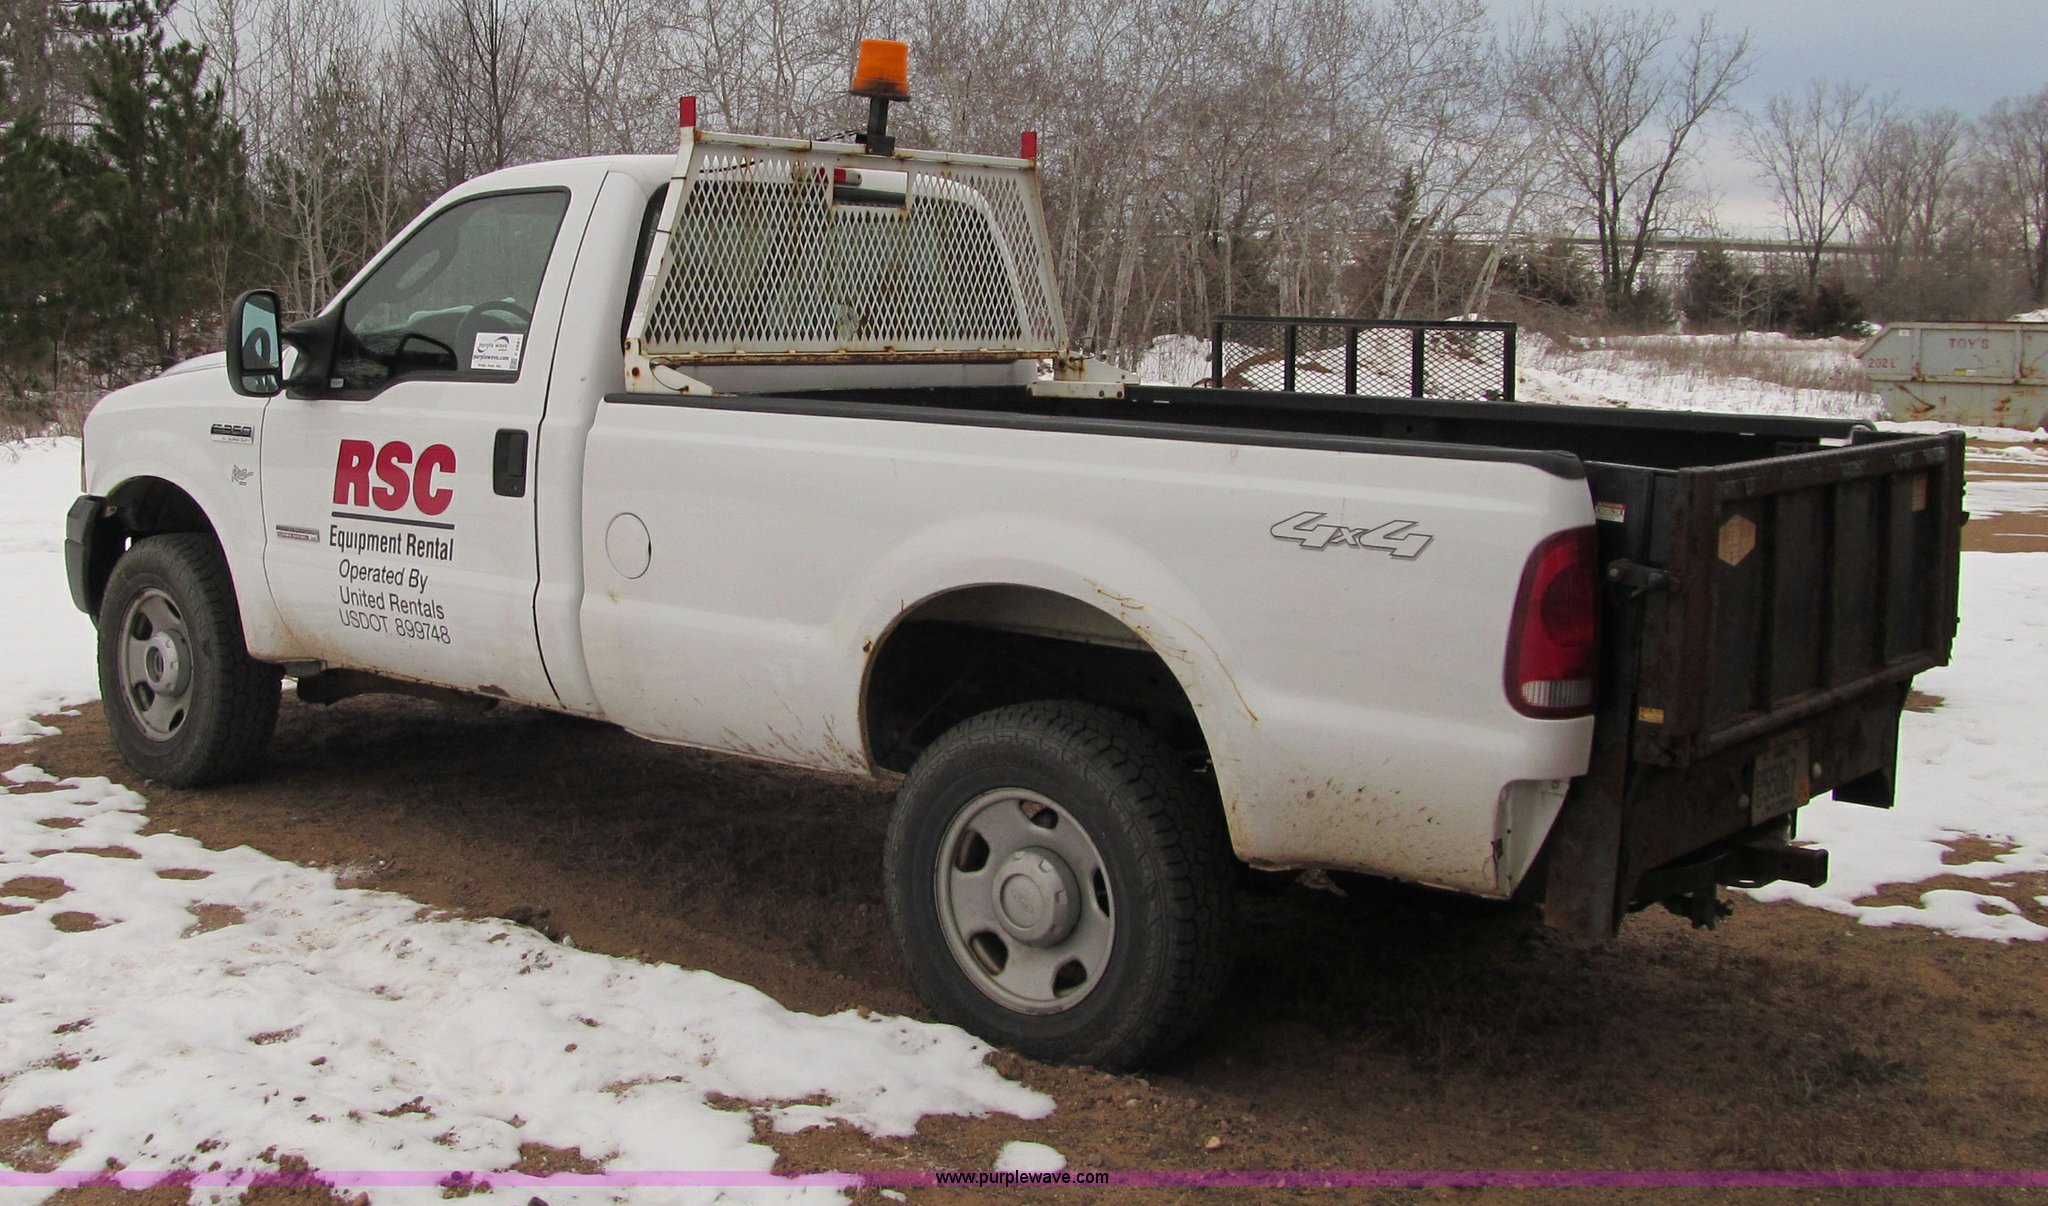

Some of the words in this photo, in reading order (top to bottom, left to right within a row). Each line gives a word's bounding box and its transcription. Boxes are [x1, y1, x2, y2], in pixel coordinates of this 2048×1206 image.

[1948, 337, 1989, 350] TOY'S
[333, 439, 457, 516] RSC
[329, 524, 402, 555] Equipment
[406, 533, 454, 561] Rental
[1270, 511, 1433, 561] 4x4
[339, 558, 405, 586] Operated
[408, 568, 428, 594] By
[339, 585, 385, 610] United
[389, 593, 445, 620] Rentals
[339, 608, 388, 633] USDOT
[395, 617, 451, 645] 899748
